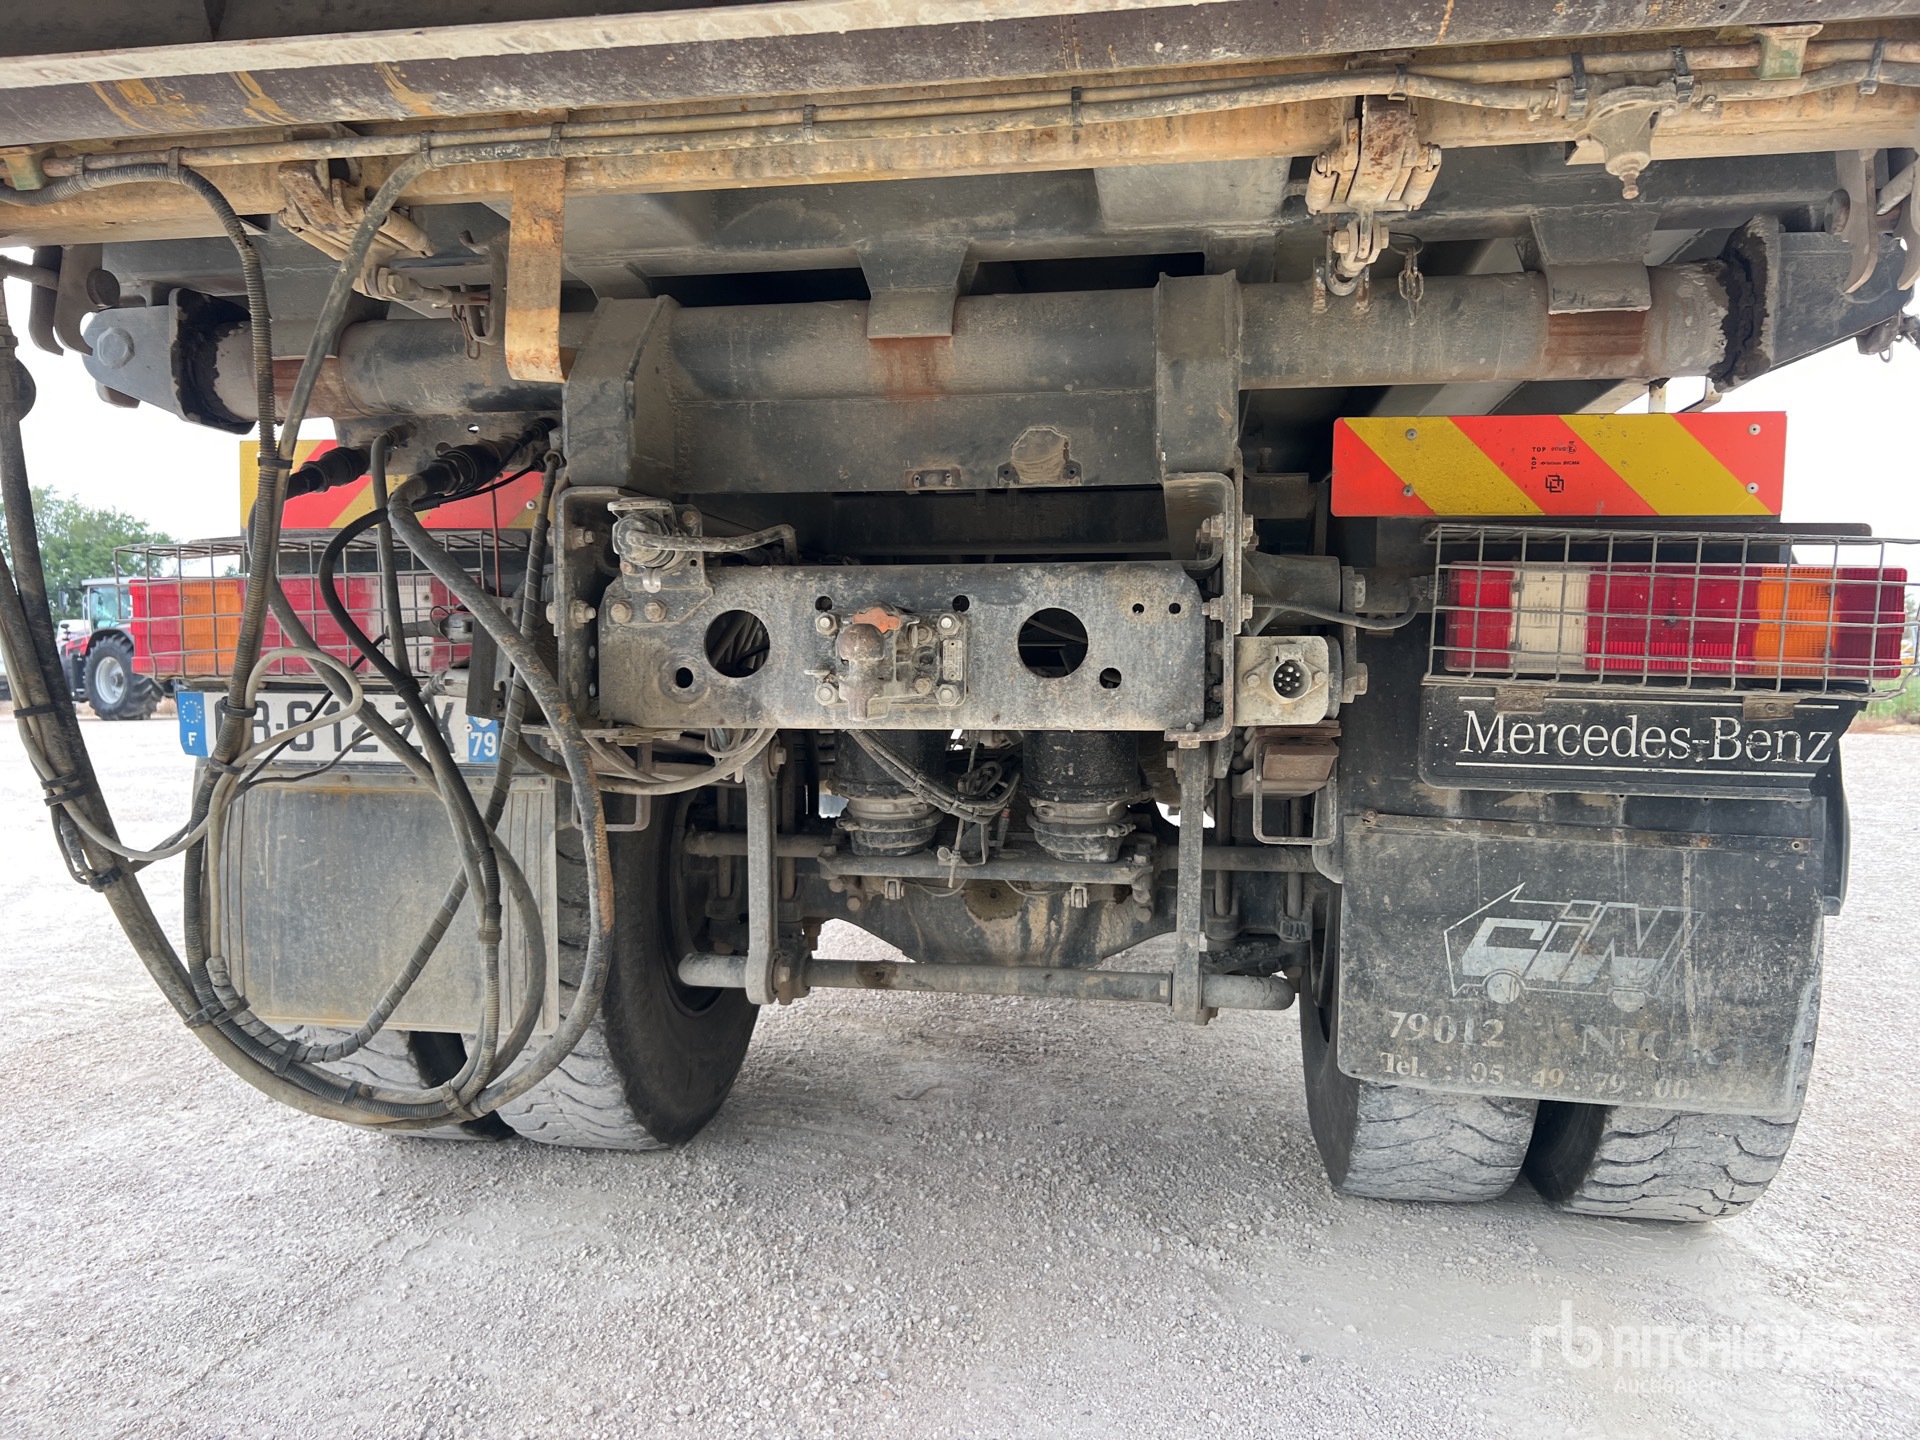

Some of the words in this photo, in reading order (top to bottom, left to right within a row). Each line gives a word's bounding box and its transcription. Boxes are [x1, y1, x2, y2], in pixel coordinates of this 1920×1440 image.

[187, 731, 198, 747] F
[470, 731, 497, 757] 79
[1459, 709, 1833, 764] Mercedes-Benz
[1388, 1010, 1504, 1048] 79012
